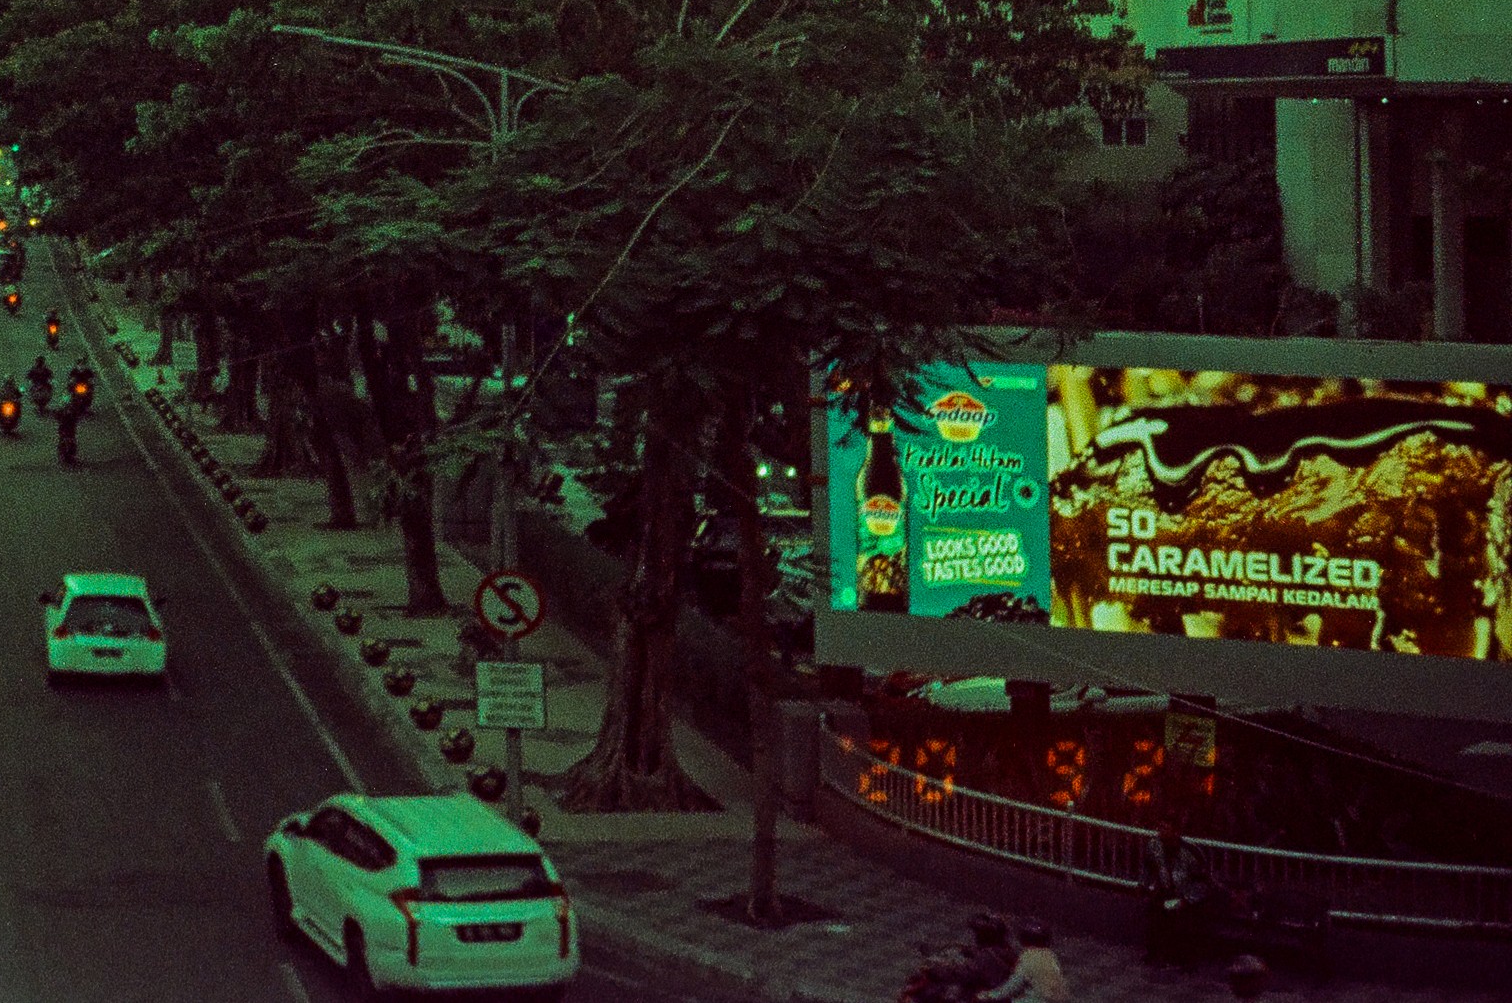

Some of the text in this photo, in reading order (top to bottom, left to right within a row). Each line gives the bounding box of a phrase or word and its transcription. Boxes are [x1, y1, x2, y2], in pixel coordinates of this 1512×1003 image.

[918, 473, 1008, 519] Special
[1107, 507, 1157, 540] SO
[926, 533, 1019, 561] LOOKS GOOD
[922, 553, 1025, 582] TASTES GOOD
[1107, 543, 1381, 589] CARAMELIZED
[1108, 576, 1380, 610] MERESAP SAMPAI KEDALAM
